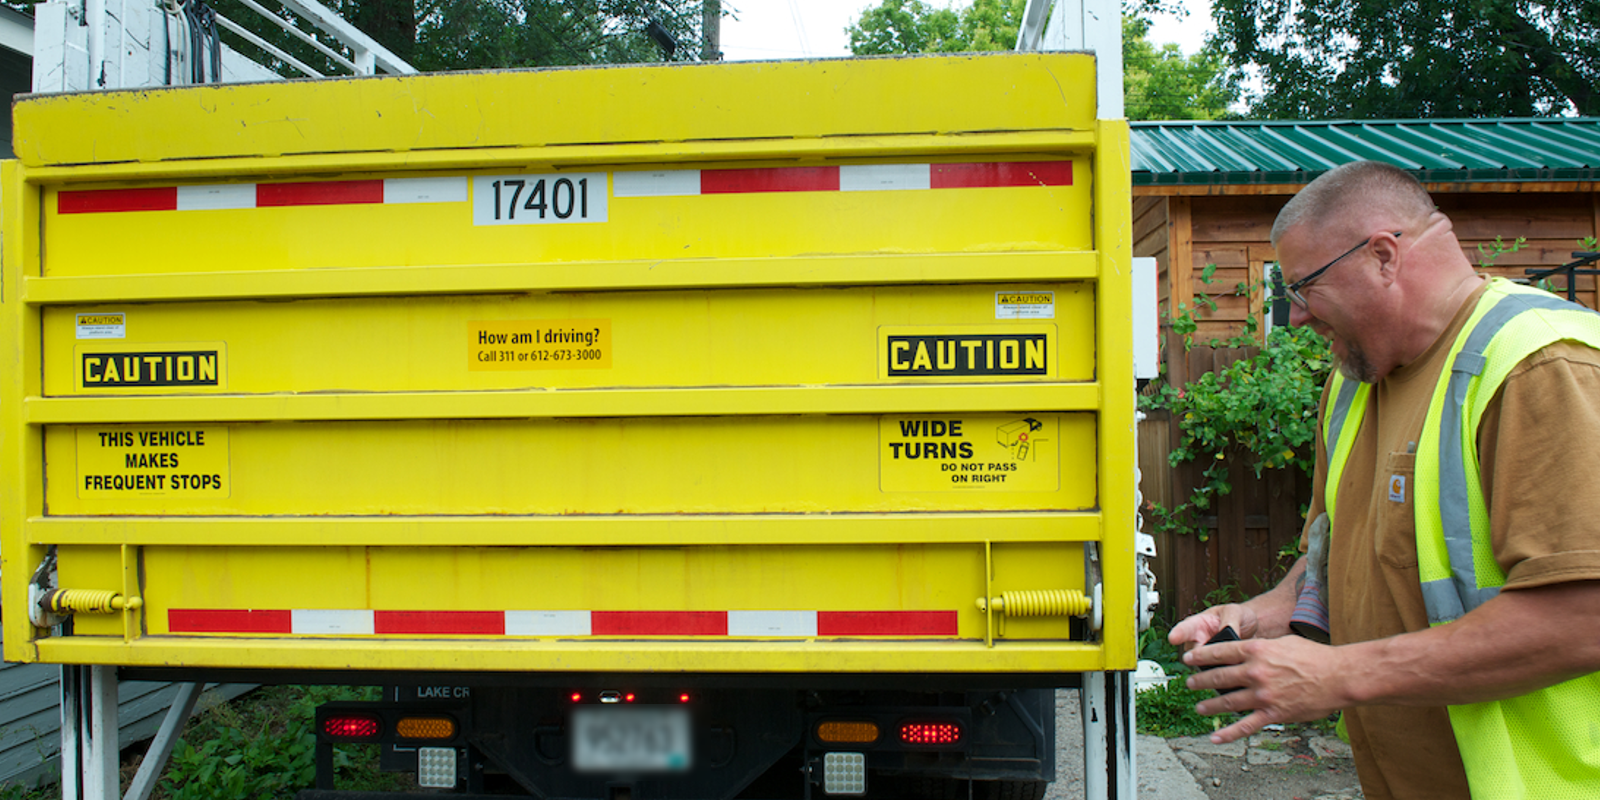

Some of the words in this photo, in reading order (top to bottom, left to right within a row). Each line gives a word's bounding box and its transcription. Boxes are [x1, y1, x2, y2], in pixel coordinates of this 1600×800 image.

[492, 177, 588, 220] 17401
[1009, 295, 1051, 303] CAUTION
[87, 316, 122, 324] CAUTION
[478, 330, 508, 344] How
[511, 333, 532, 344] am
[536, 329, 540, 343] I
[544, 328, 600, 347] driving?
[478, 350, 497, 362] Call
[499, 350, 515, 362] 311
[518, 352, 529, 361] or
[530, 349, 602, 361] 612-673-3000
[890, 340, 1044, 371] CAUTION
[84, 355, 216, 383] CAUTION
[899, 420, 963, 437] WIDE
[98, 432, 134, 447] THIS
[138, 431, 205, 446] VEHICLE
[889, 442, 974, 460] TURNS
[125, 453, 179, 468] MAKES
[941, 463, 957, 471] DO
[961, 463, 984, 471] NOT
[988, 463, 1017, 471] PASS
[85, 474, 166, 491] FREQUENT
[170, 474, 222, 490] STOPS
[951, 474, 969, 483] ON
[972, 474, 1007, 483] RIGHT
[417, 685, 451, 698] LAKE
